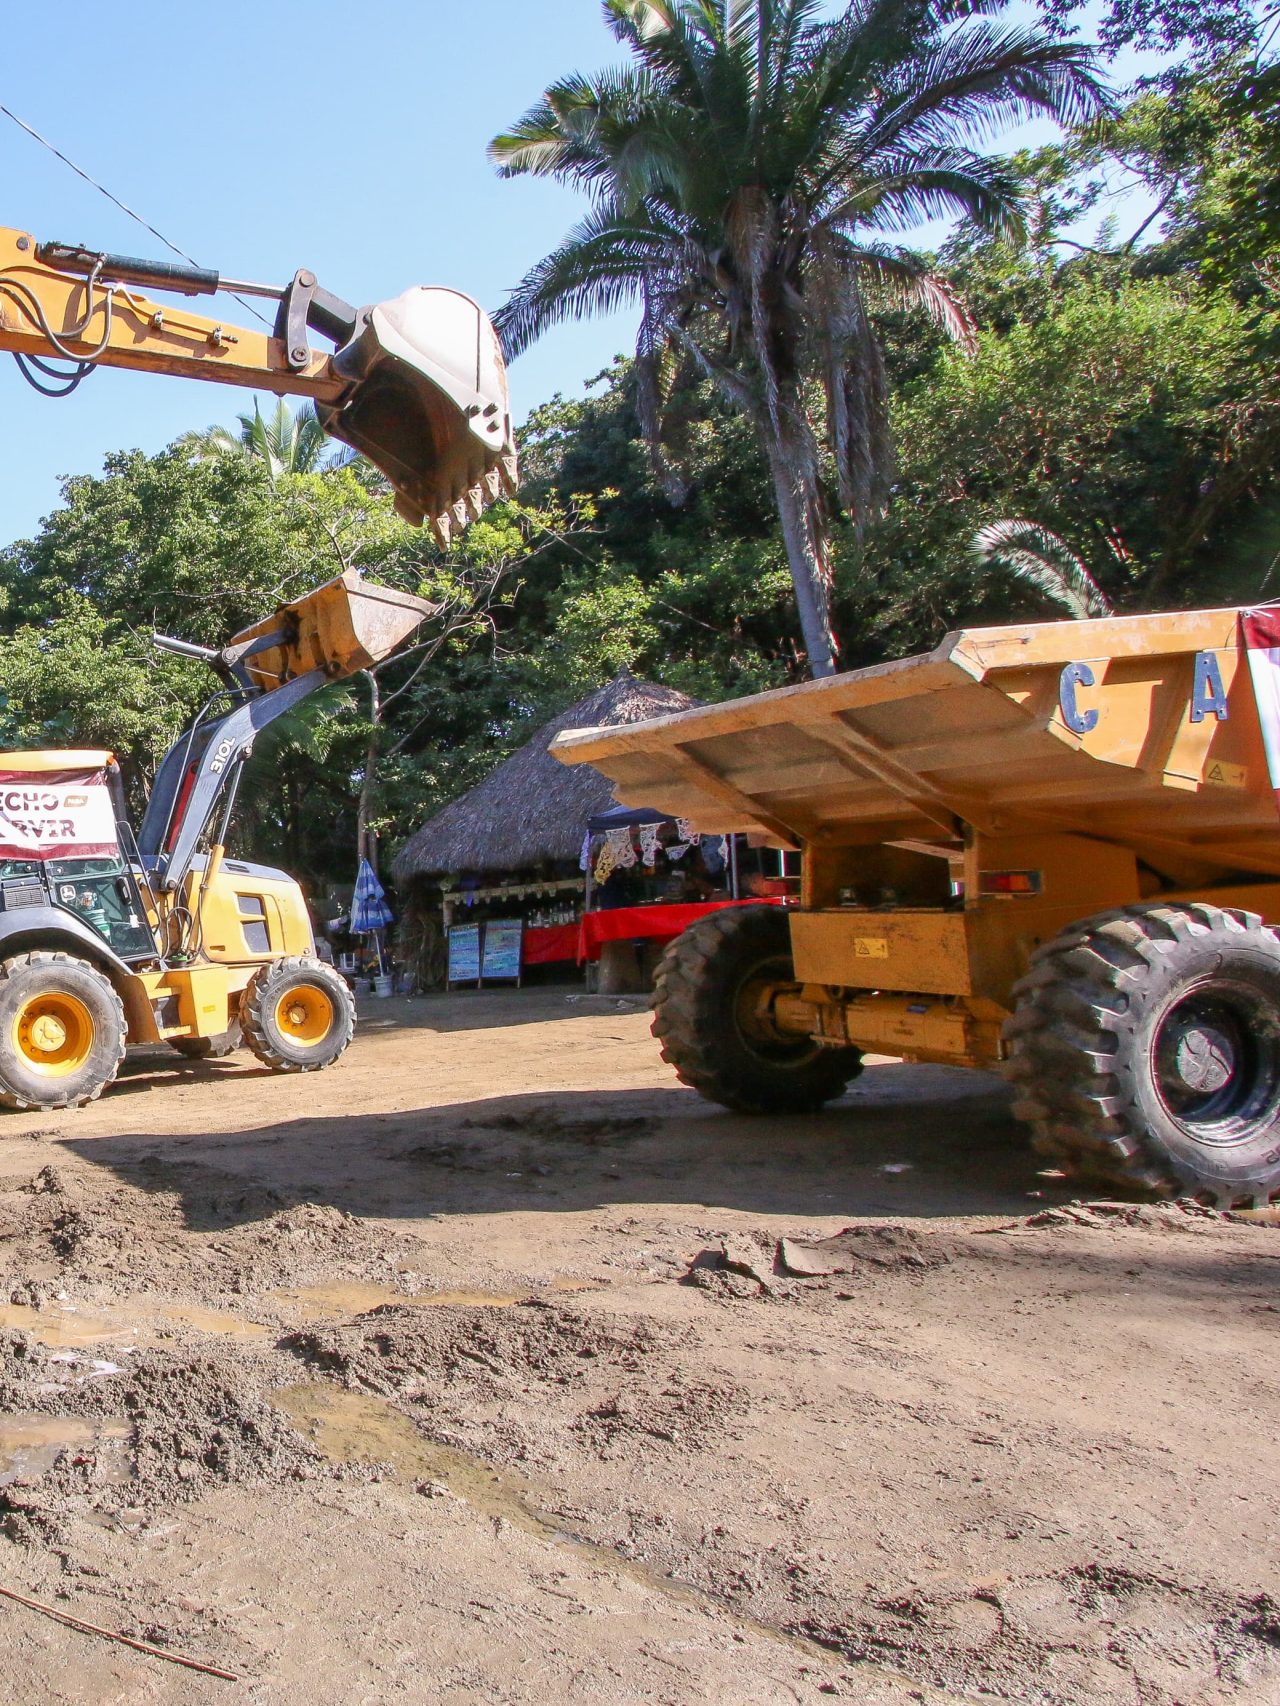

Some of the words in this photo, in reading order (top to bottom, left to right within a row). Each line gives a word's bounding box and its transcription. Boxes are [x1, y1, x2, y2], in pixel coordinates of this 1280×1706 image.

[1059, 662, 1100, 733] C
[1191, 652, 1228, 723] A
[210, 737, 236, 774] 310L
